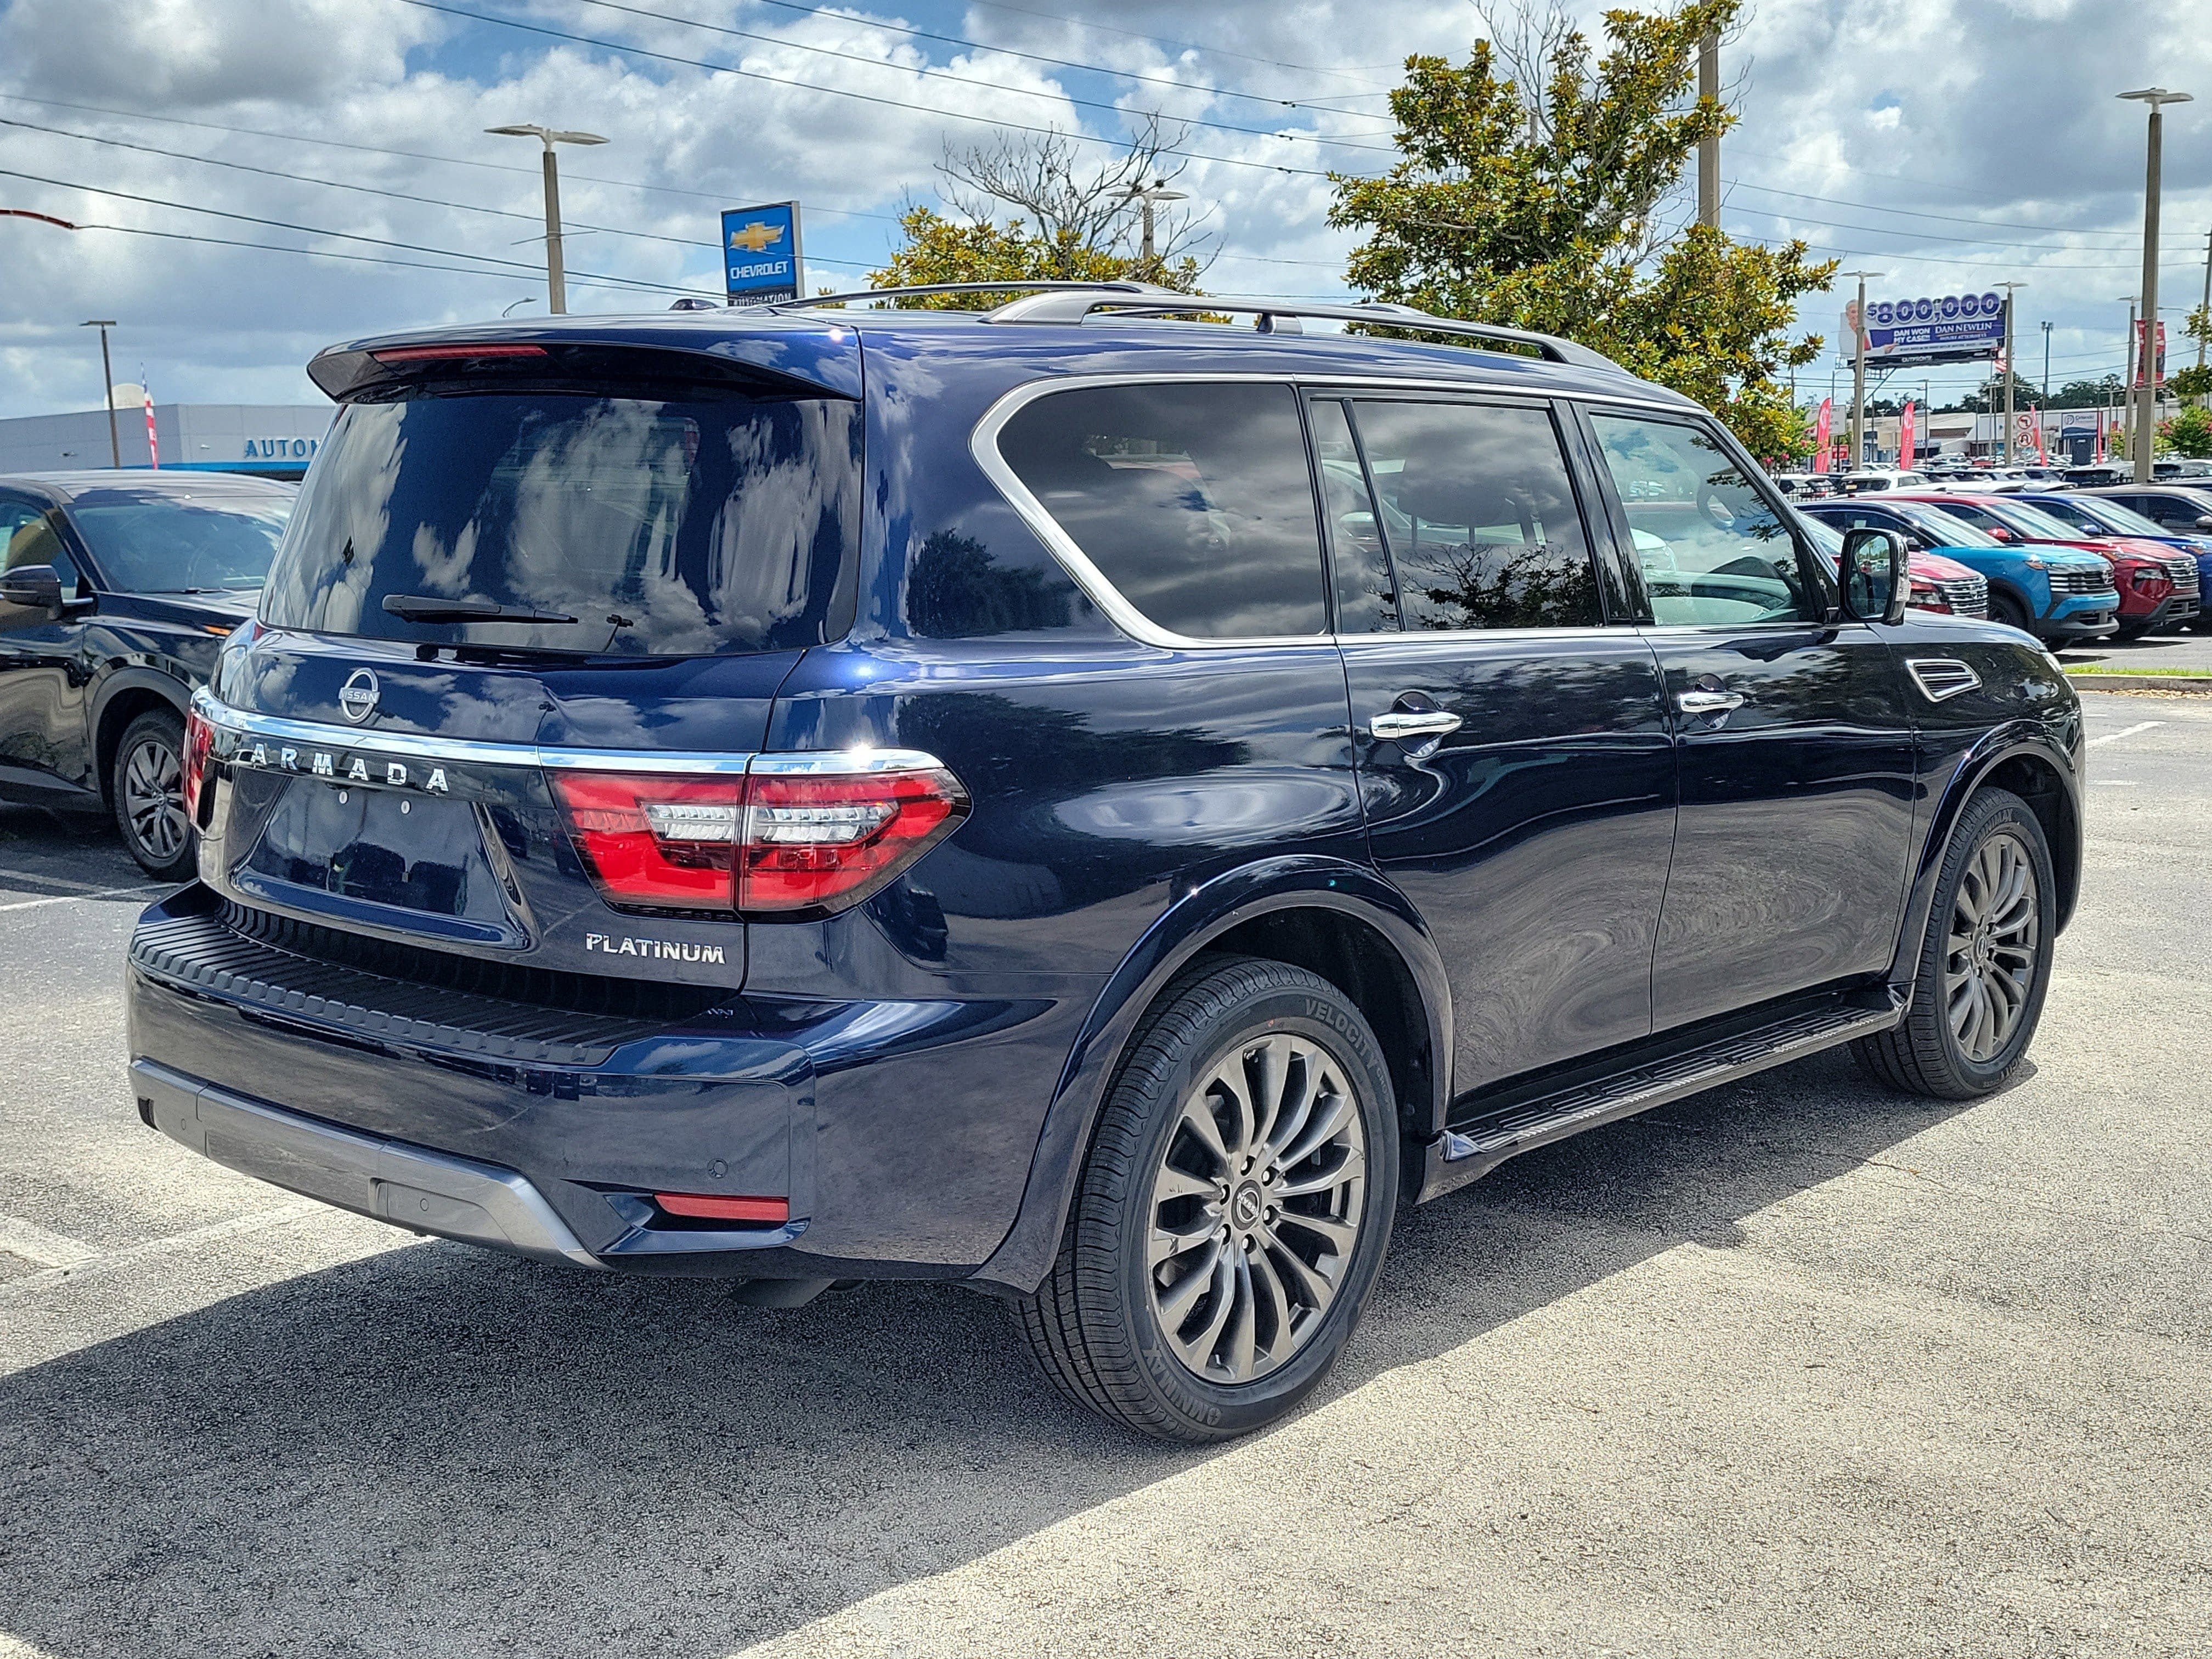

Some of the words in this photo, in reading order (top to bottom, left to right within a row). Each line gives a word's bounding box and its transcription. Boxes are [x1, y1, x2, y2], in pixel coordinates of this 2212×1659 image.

[730, 261, 788, 279] CHEVROLET
[1866, 292, 2000, 325] $800,000
[1935, 324, 1954, 334] DAN
[1955, 322, 1992, 332] NEWLIN
[341, 690, 377, 701] NISSAN
[250, 743, 449, 792] ARMADA
[585, 932, 725, 964] PLATINUM
[1305, 997, 1381, 1069] VELOCITY
